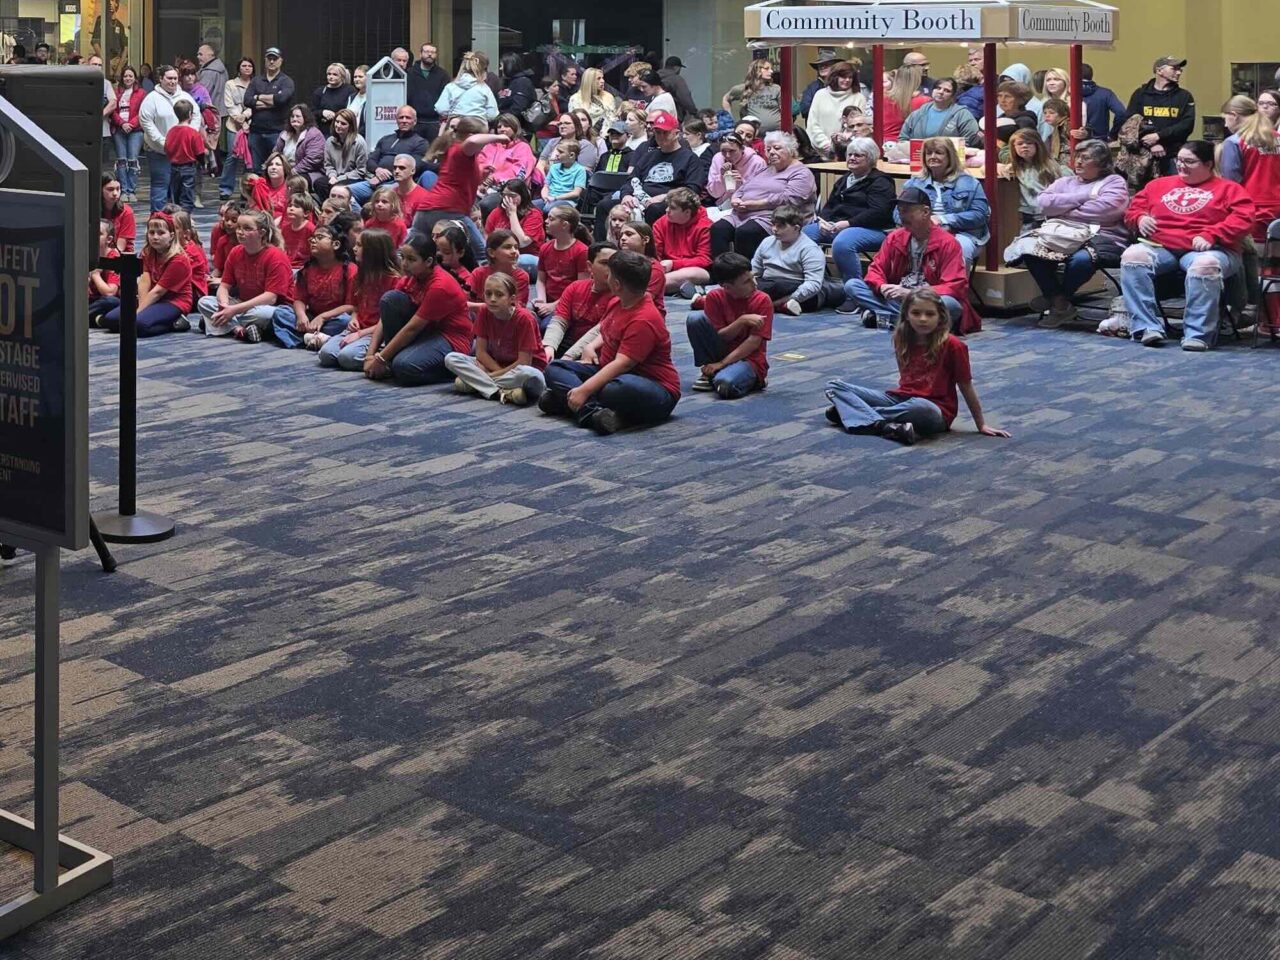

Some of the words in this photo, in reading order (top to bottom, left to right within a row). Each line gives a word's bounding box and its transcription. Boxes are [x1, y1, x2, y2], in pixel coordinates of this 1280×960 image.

[765, 9, 895, 38] Community
[903, 8, 976, 31] Booth
[1022, 8, 1080, 40] Community
[1082, 11, 1111, 34] Booth
